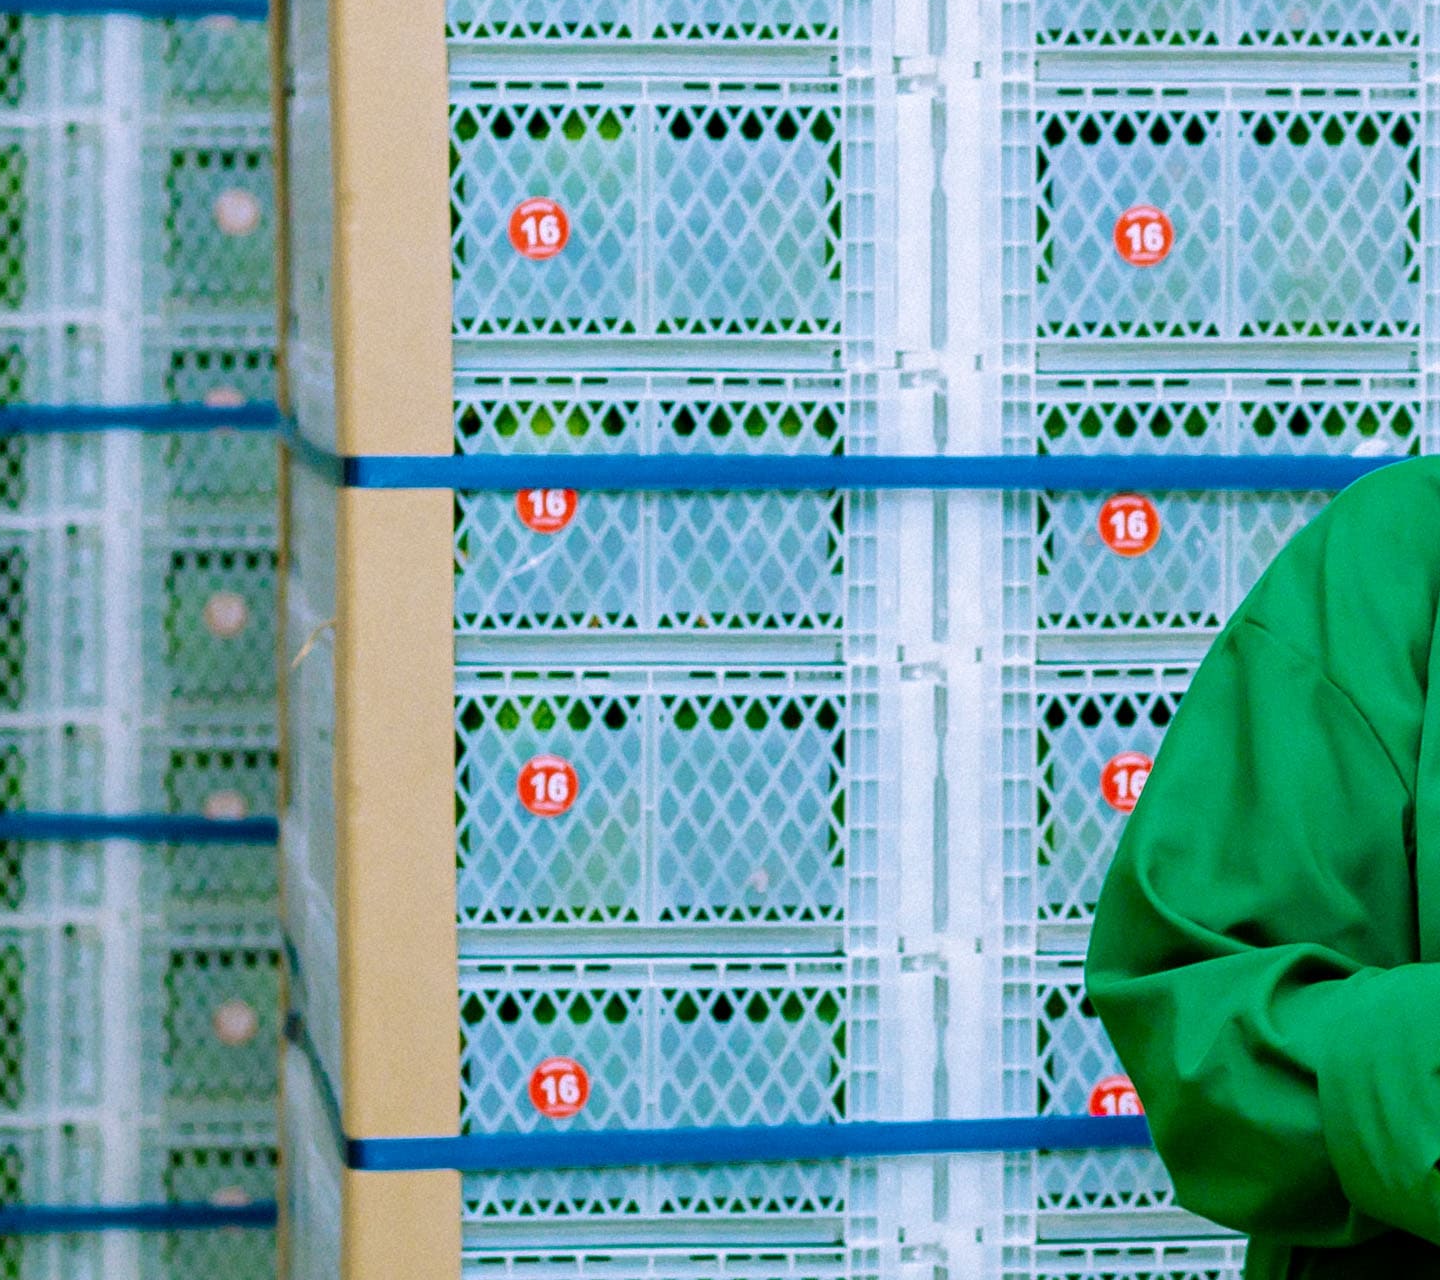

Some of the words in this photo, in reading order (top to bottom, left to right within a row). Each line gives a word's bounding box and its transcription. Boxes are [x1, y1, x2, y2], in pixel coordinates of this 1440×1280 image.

[520, 214, 560, 245] 16
[1125, 222, 1164, 252] 16
[528, 489, 567, 518] 16
[1110, 510, 1148, 540] 16
[530, 771, 569, 802] 16
[1112, 769, 1148, 798] 16
[540, 1073, 581, 1105] 16
[1101, 1091, 1139, 1115] 16
